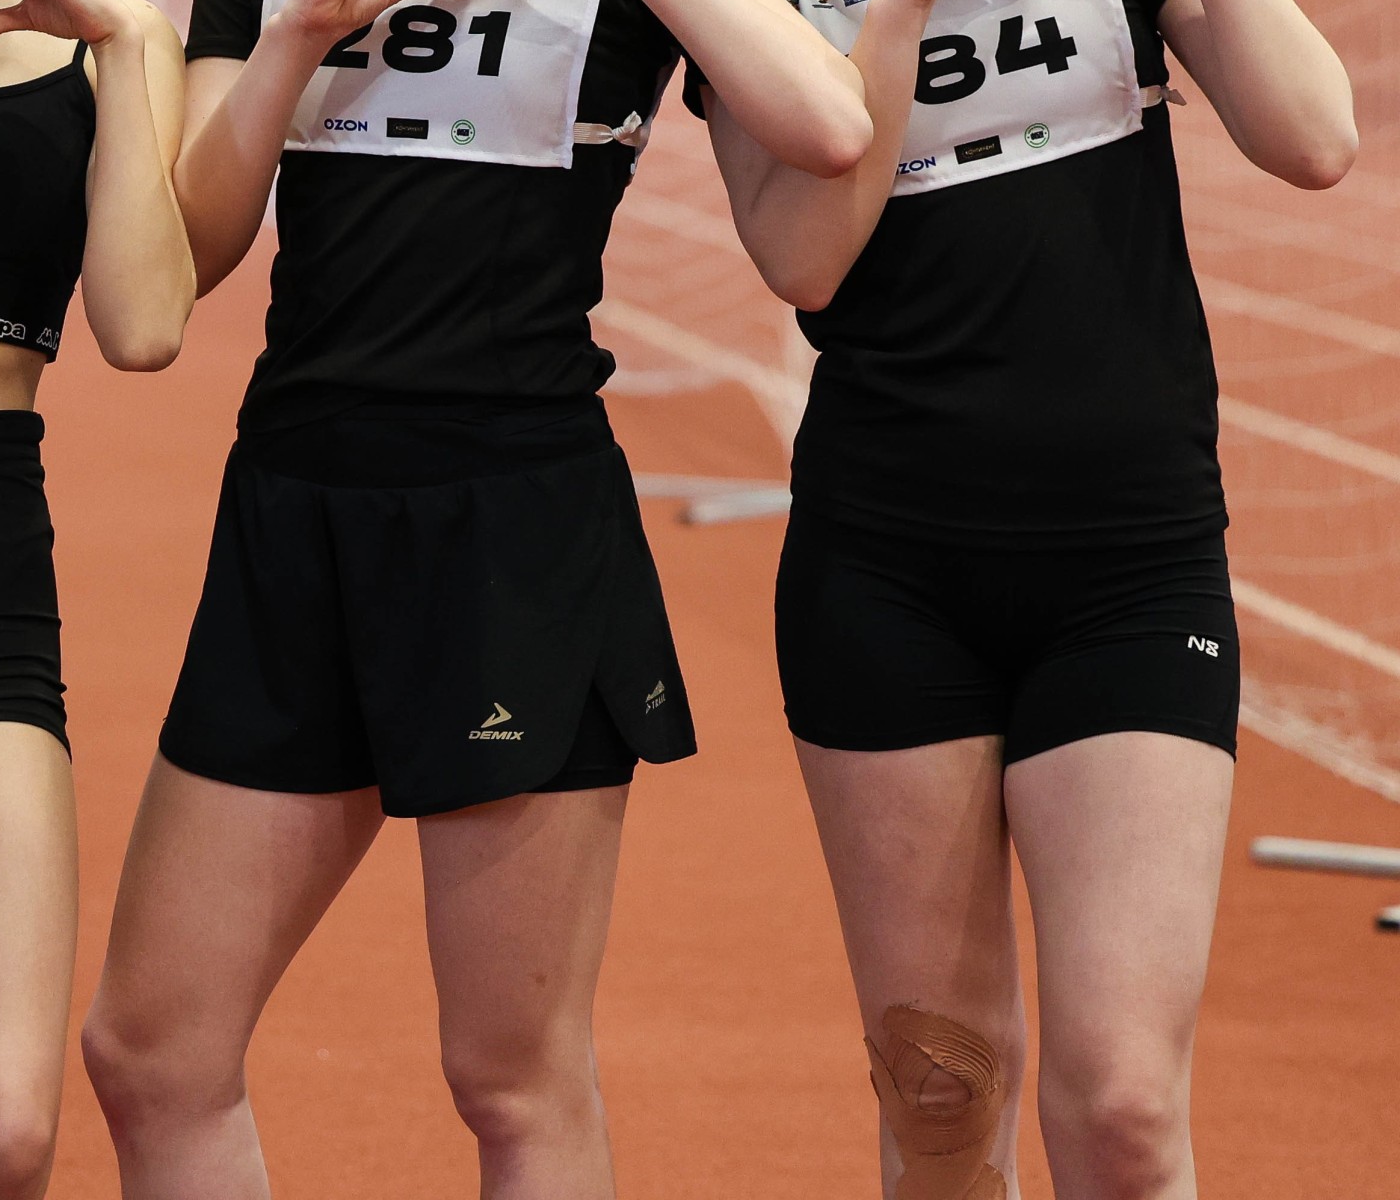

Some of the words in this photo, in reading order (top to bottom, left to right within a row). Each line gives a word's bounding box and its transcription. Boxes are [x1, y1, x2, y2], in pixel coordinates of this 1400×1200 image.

[913, 14, 1078, 105] 84
[323, 118, 368, 132] OZON
[896, 155, 937, 175] ZON
[468, 730, 525, 741] DEMIX
